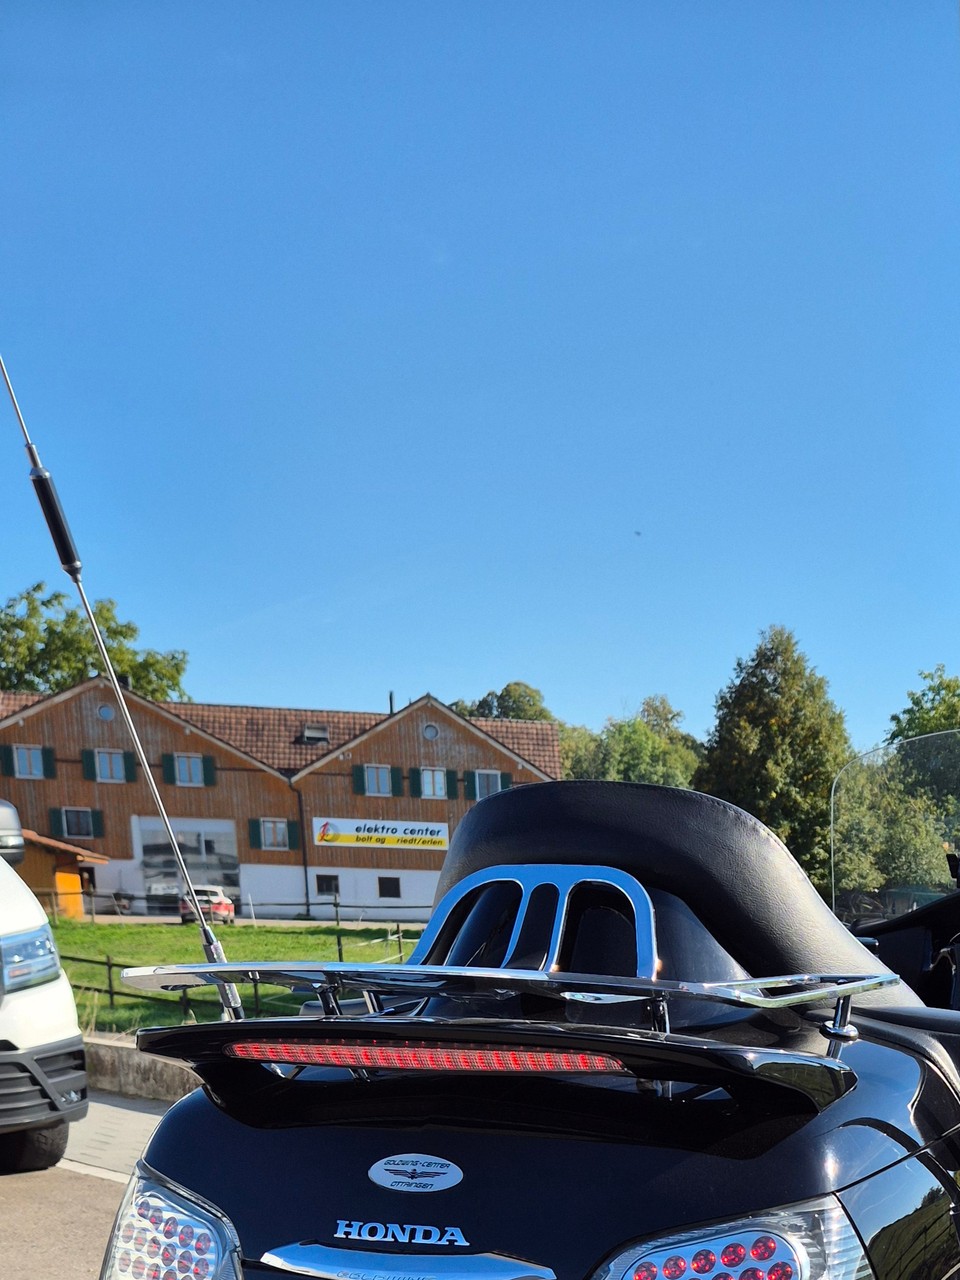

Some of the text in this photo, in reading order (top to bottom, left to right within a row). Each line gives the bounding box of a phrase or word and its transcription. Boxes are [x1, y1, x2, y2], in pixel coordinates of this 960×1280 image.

[355, 823, 442, 837] elektro center
[375, 837, 386, 845] ag
[334, 1220, 470, 1246] HONDA
